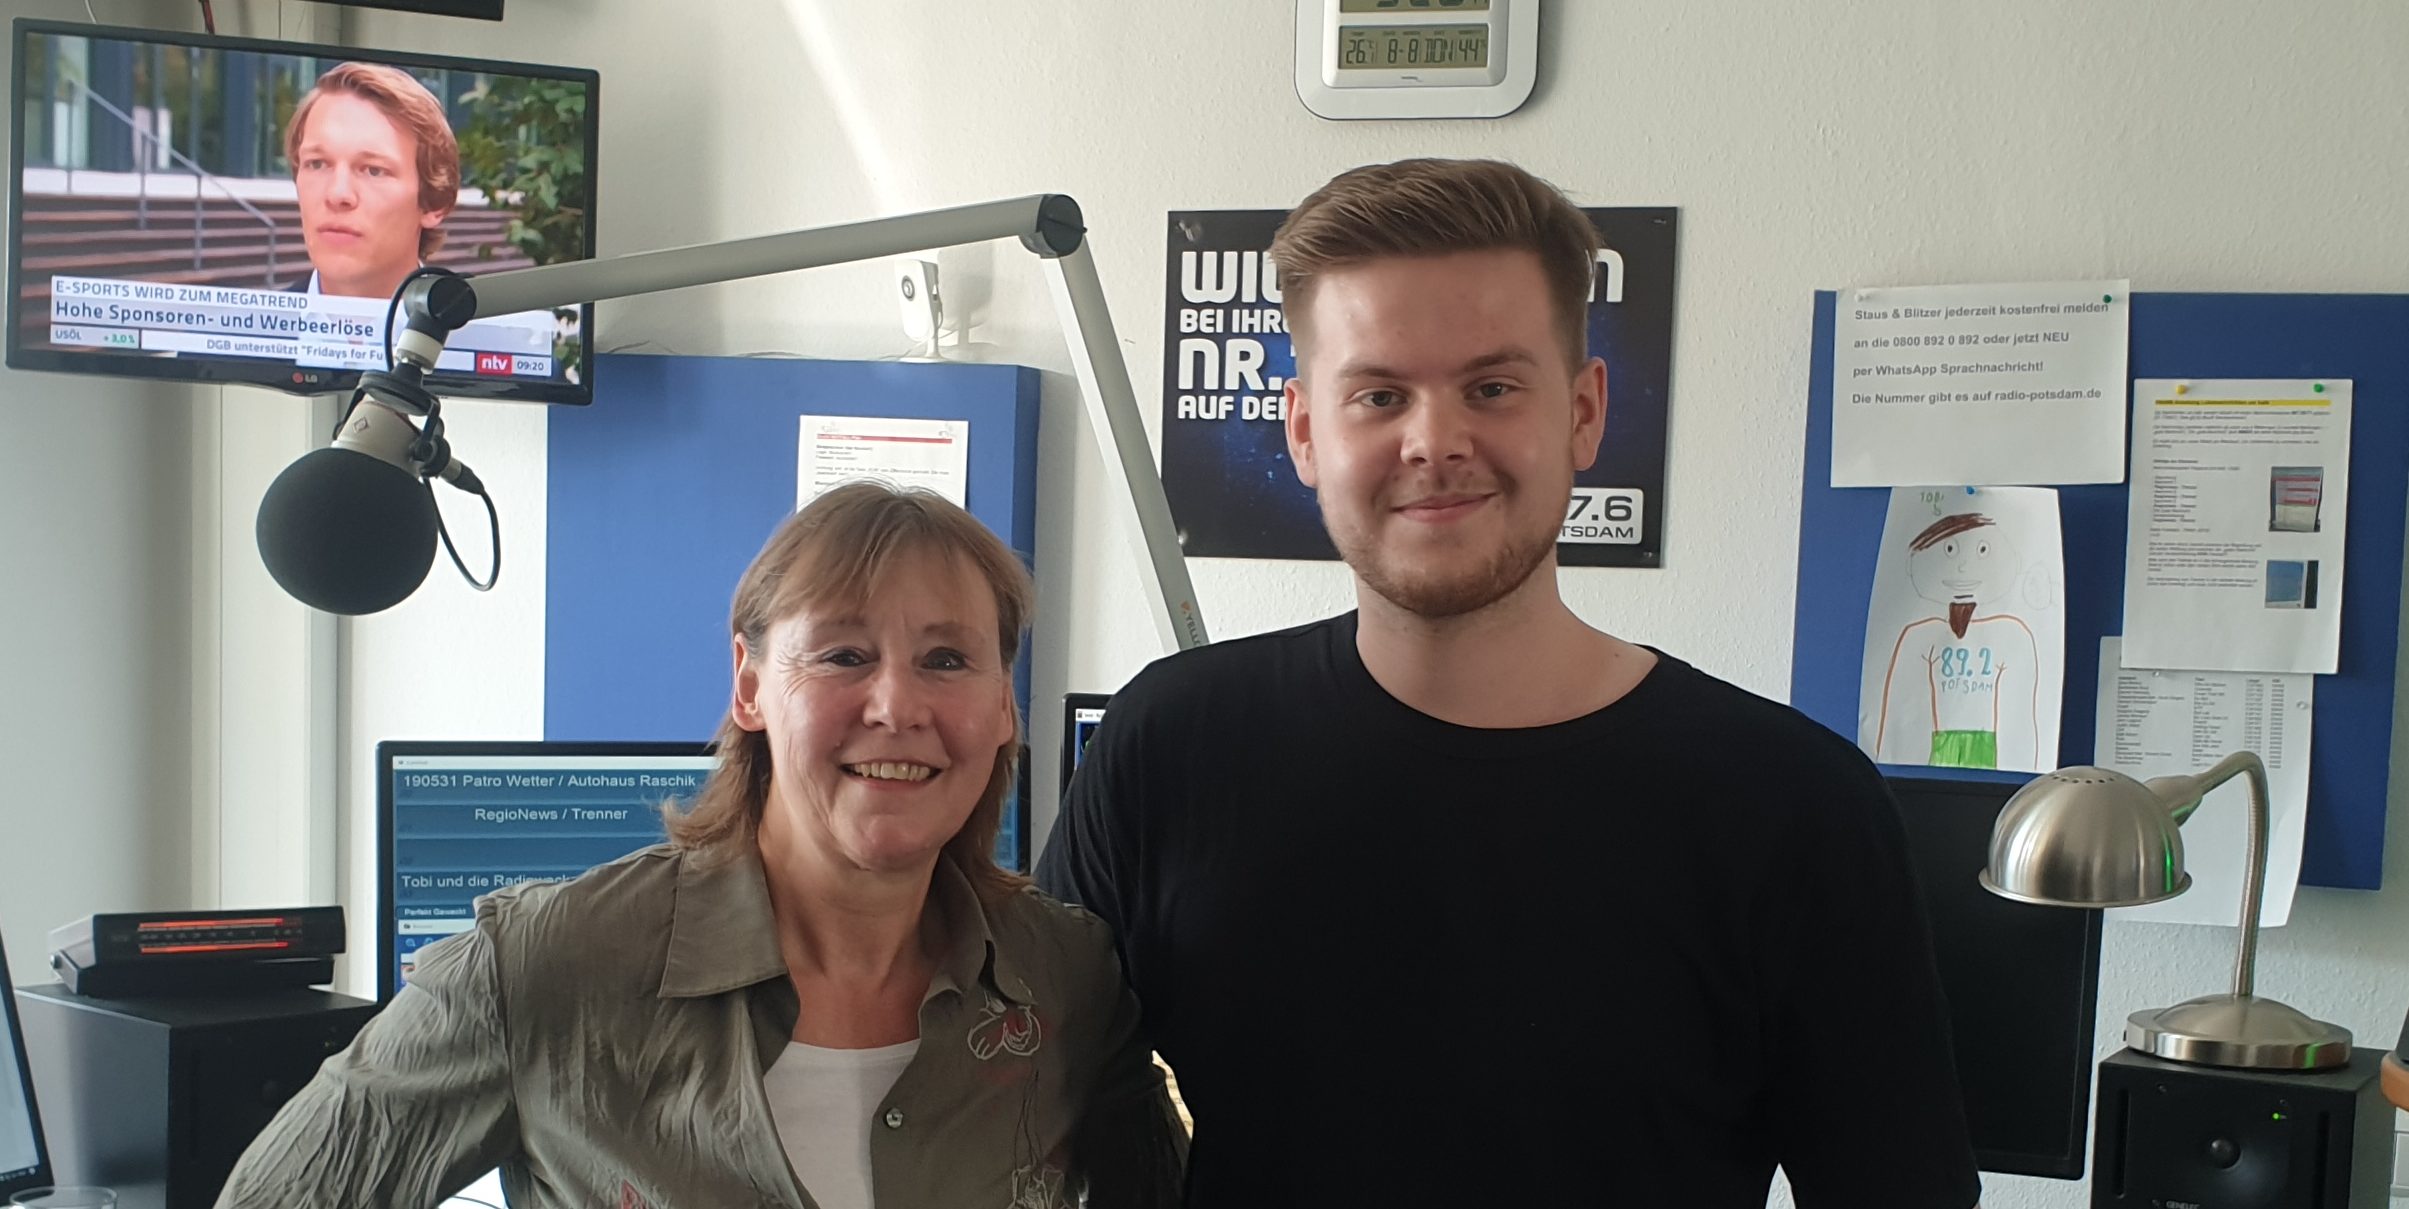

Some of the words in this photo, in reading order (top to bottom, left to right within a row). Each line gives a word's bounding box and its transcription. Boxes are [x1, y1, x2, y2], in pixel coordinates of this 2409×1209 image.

[56, 280, 130, 298] E-SPORTS
[135, 286, 174, 300] WIRD
[179, 289, 211, 303] ZUM
[217, 291, 308, 309] MEGATREND
[56, 301, 103, 319] Hohe
[109, 304, 214, 326] Sponsoren-
[221, 313, 253, 329] und
[260, 314, 374, 337] Werbeerlöse
[1855, 309, 1888, 320] Staus
[1891, 309, 1901, 319] &
[1904, 307, 1942, 319] Blitzer
[1944, 305, 1997, 320] jederzeit
[2000, 303, 2061, 316] kostenfrei
[2063, 302, 2109, 314] melden
[1179, 308, 1224, 334] BEI
[1854, 339, 1868, 348] an
[1871, 337, 1889, 348] die
[1893, 336, 1921, 348] 0800
[1923, 335, 1945, 347] 892
[1948, 335, 1955, 346] 0
[1958, 334, 1980, 346] 892
[1983, 333, 2010, 345] oder
[2012, 332, 2040, 346] jetzt
[2043, 332, 2070, 343] NEU
[207, 339, 231, 350] DGB
[234, 341, 298, 355] unterstützt
[350, 348, 366, 360] for
[370, 350, 383, 361] Fu
[482, 355, 507, 370] ntv
[517, 361, 543, 371] 09:20
[1178, 338, 1283, 391] NR.
[1853, 368, 1873, 378] per
[1875, 364, 1937, 377] WhatsApp
[1940, 361, 2044, 376] Sprachnachricht!
[1852, 393, 1872, 405] Die
[1875, 392, 1925, 404] Nummer
[1928, 391, 1952, 406] gibt
[1955, 393, 1969, 402] es
[1972, 390, 1993, 402] auf
[1994, 388, 2102, 404] radio-potsdam.de
[1177, 394, 1235, 420] AUF
[1568, 495, 1633, 522] 7.6
[1562, 525, 1634, 539] TSDAM
[1940, 646, 1992, 679] 89.2
[404, 775, 457, 788] 190531
[463, 775, 502, 787] Patro
[506, 775, 555, 787] Wetter
[567, 775, 635, 788] Autohaus
[640, 774, 696, 787] Raschik
[474, 808, 558, 823] RegioNews
[571, 808, 628, 821] Trenner
[401, 875, 433, 888] Tobi
[437, 875, 464, 888] und
[468, 875, 489, 888] die
